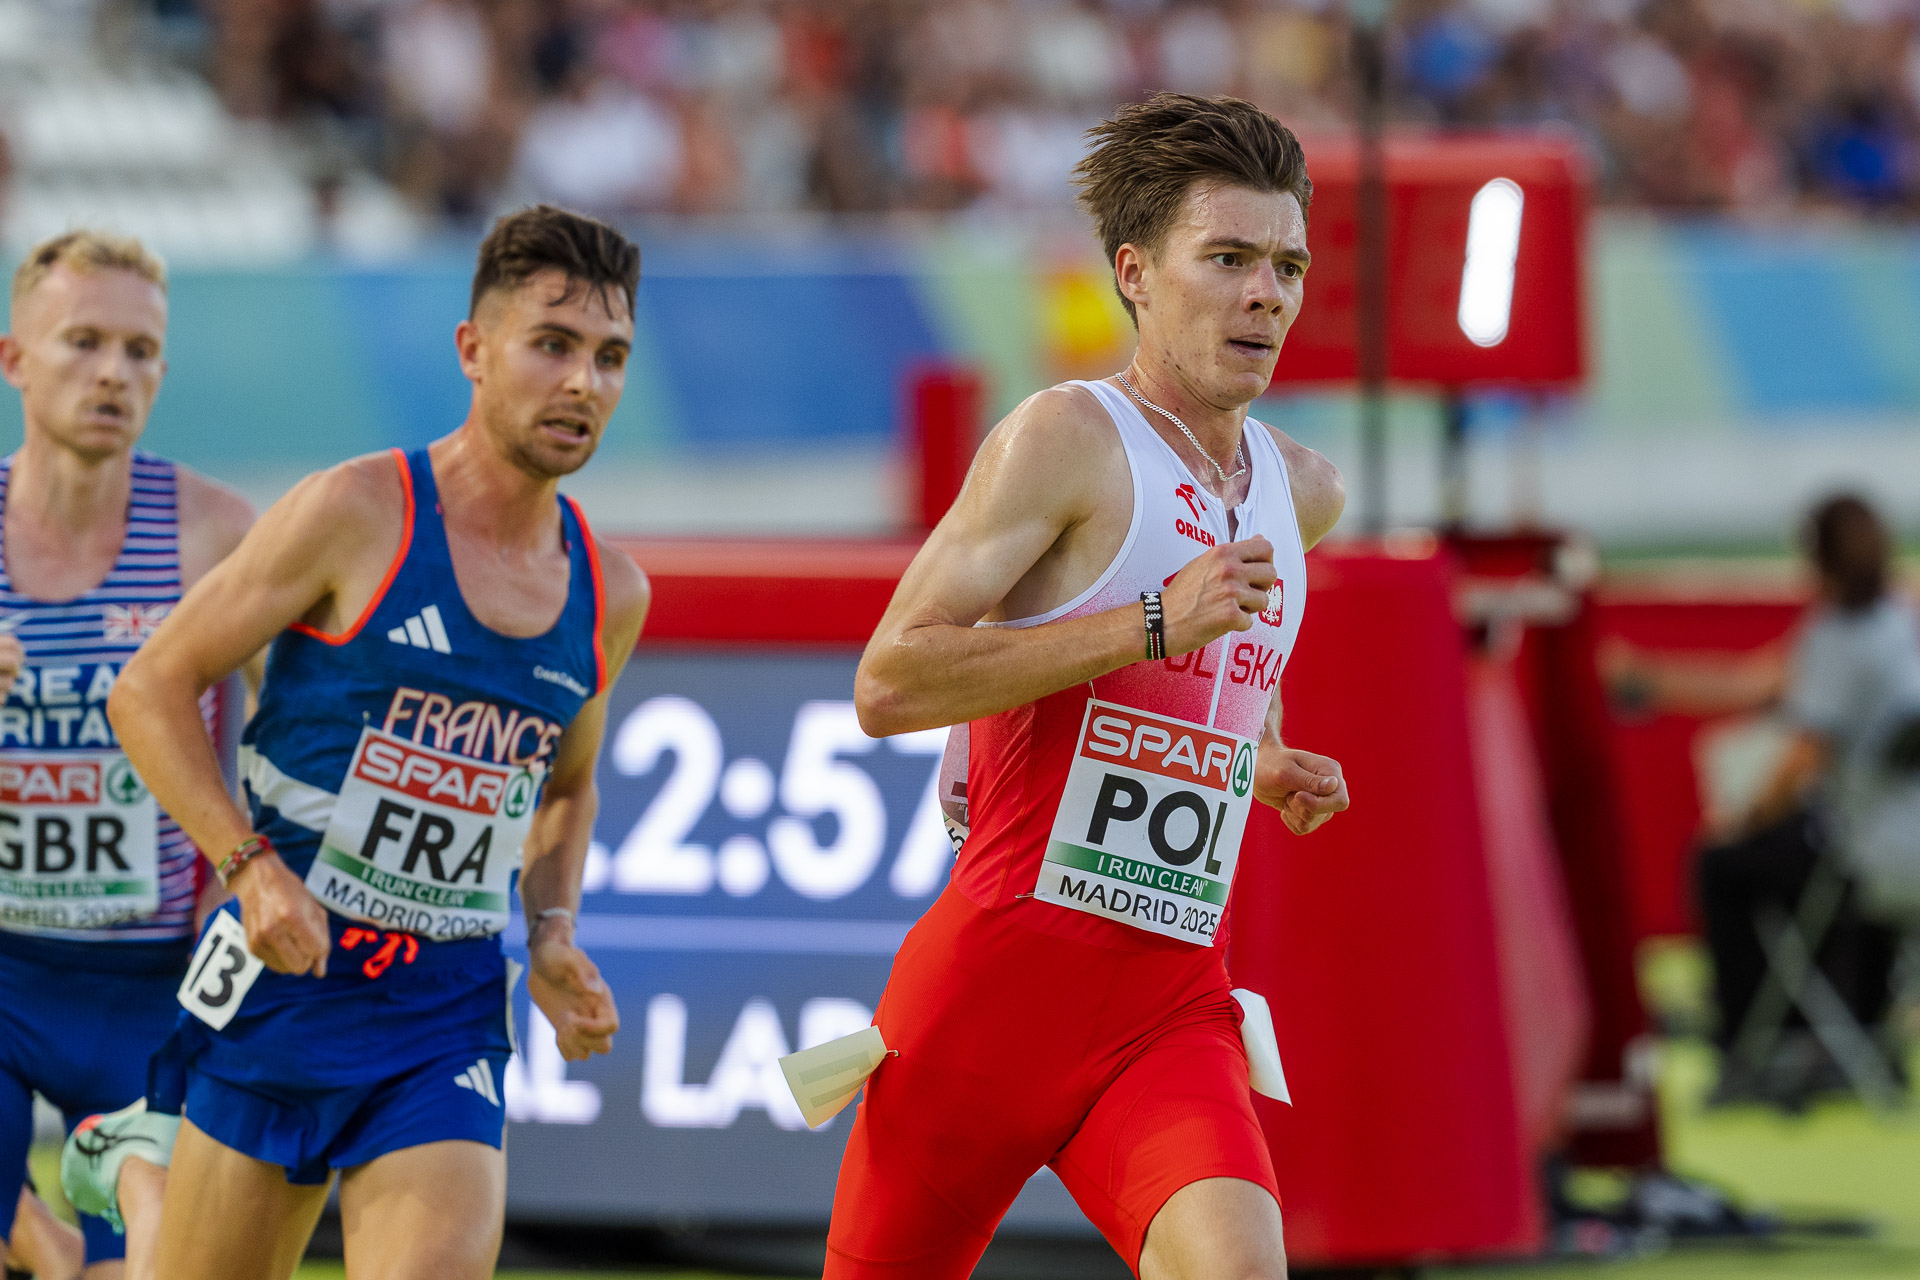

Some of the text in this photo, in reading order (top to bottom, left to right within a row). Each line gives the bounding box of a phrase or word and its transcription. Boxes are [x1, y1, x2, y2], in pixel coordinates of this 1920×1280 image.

[1175, 518, 1216, 548] ORLEN
[9, 664, 118, 706] REA
[1130, 643, 1283, 697] LSKA
[0, 706, 121, 747] RITA
[382, 686, 563, 772] FRANCE
[1088, 715, 1232, 783] SPAR
[0, 765, 96, 801] PAR
[360, 741, 505, 811] SPAR
[582, 693, 952, 901] 2:57
[360, 796, 494, 884] FRA
[1085, 772, 1228, 876] POL
[361, 866, 370, 881] I
[369, 870, 415, 898] RUN
[1097, 854, 1105, 871] I
[1107, 857, 1154, 885] RUN
[325, 877, 433, 932] MADRID
[1058, 874, 1218, 937] MADRID 2025
[188, 934, 247, 1008] 13
